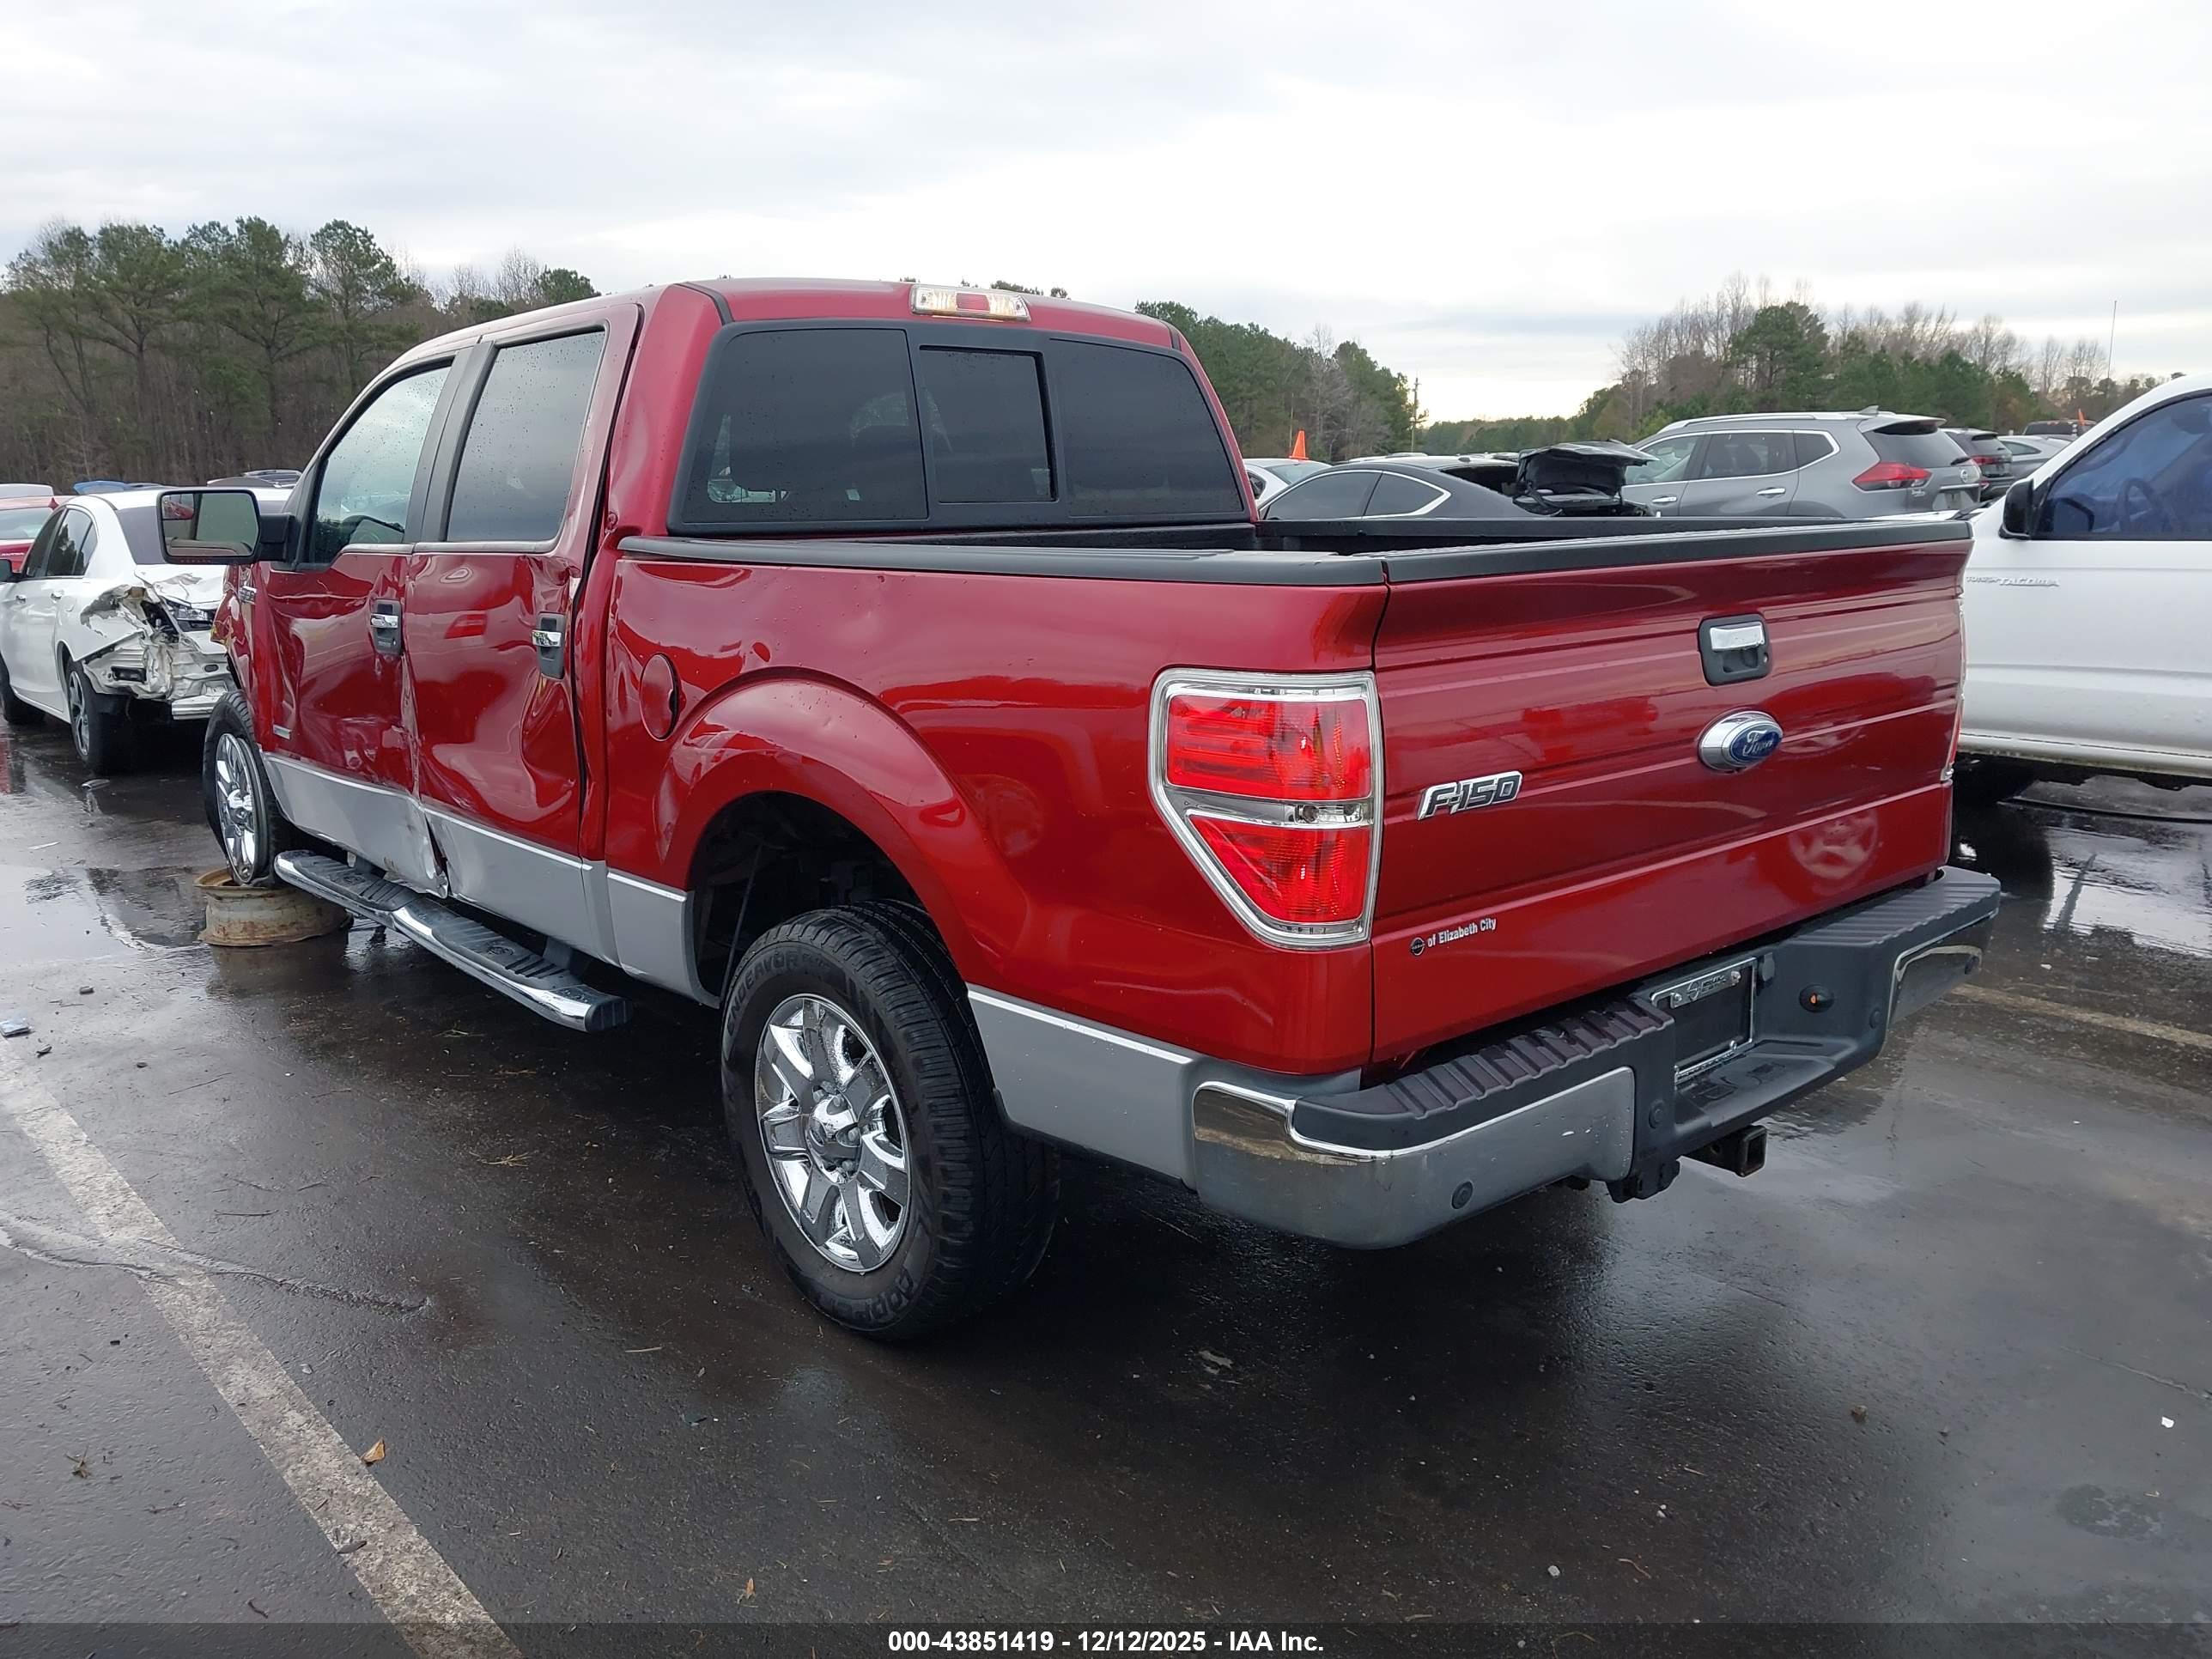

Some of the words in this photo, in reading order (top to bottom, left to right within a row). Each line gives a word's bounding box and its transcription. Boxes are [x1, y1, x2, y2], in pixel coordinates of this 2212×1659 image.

[1742, 729, 1773, 757] Ford
[1418, 770, 1523, 821] F-150
[1427, 933, 1437, 948] of
[1437, 922, 1478, 944] Elizabeth
[1480, 917, 1497, 932] City
